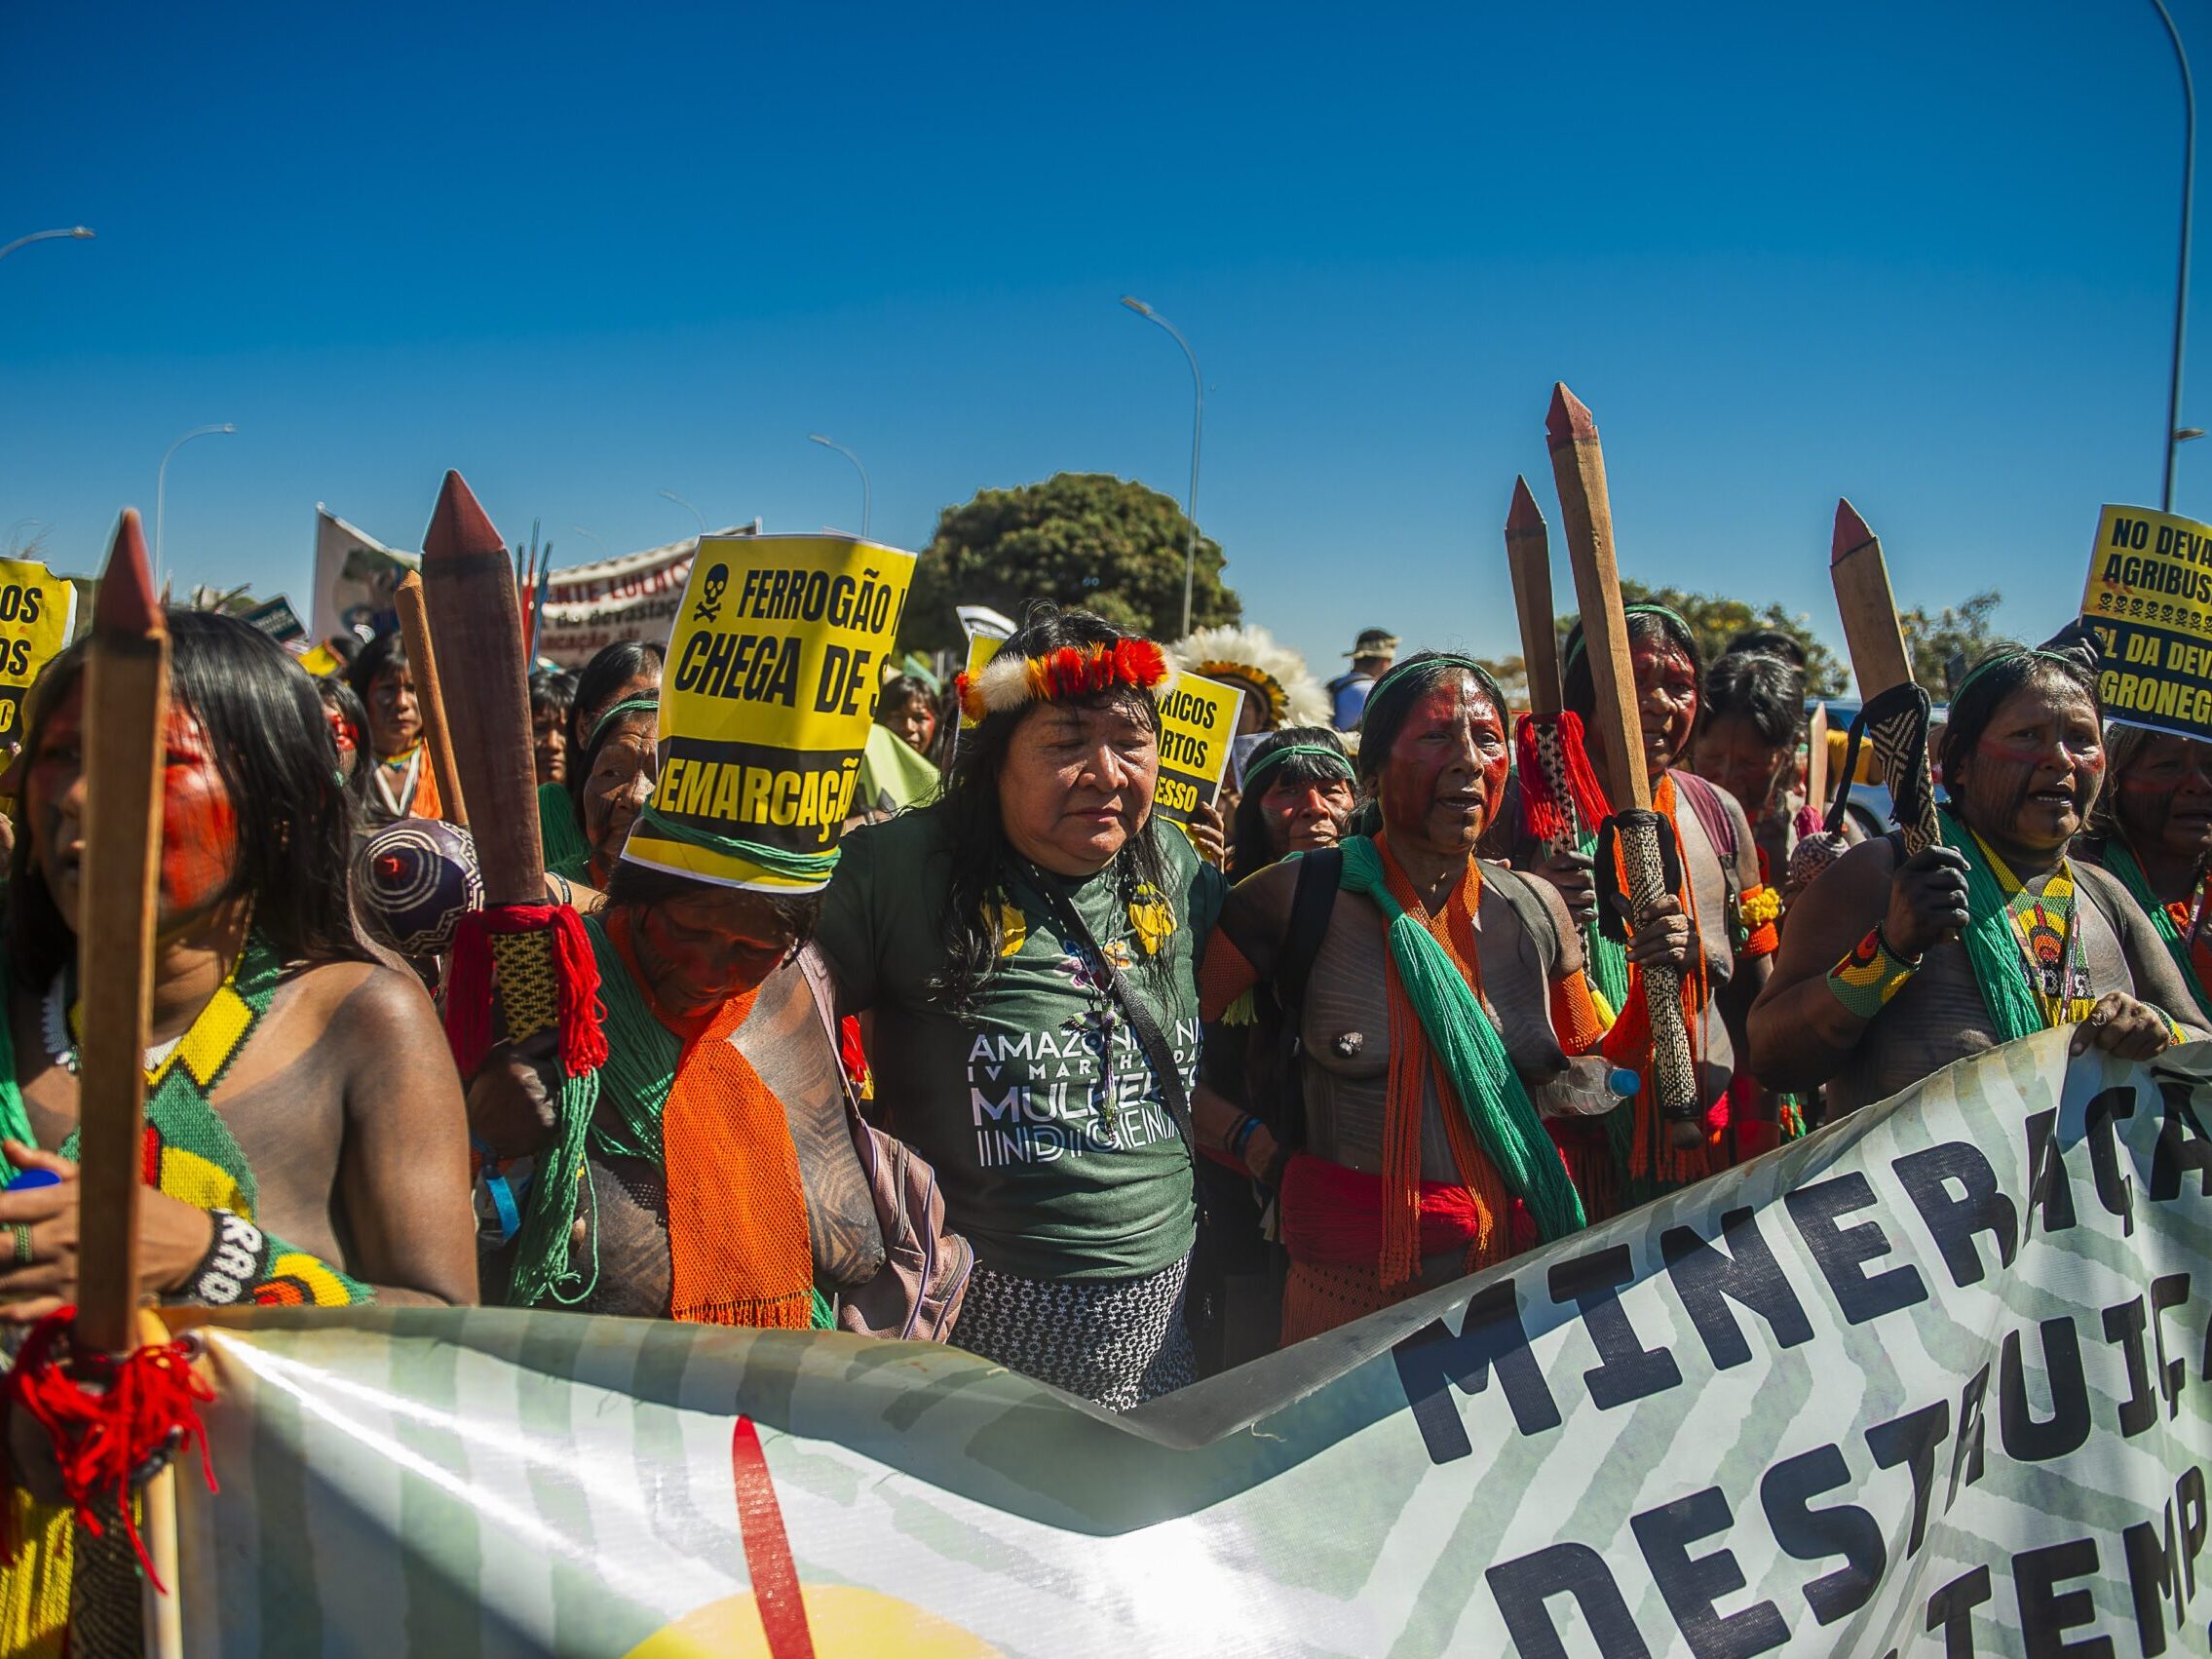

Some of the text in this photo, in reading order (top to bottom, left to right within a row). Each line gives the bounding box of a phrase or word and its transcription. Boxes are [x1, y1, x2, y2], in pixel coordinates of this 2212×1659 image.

[2111, 517, 2150, 551] NO
[0, 584, 43, 624] OS
[737, 567, 892, 635] FERROGÃO
[2102, 553, 2212, 606] AGRIBUS
[674, 630, 802, 708] CHEGA
[814, 643, 871, 716] DE
[2124, 633, 2160, 667] DA
[2166, 639, 2212, 681] DEV
[2102, 669, 2212, 726] GRONEG
[650, 757, 860, 843] EMARCAÇÃ
[1484, 1272, 2212, 1659] DESTRUIÇ
[1926, 1465, 2212, 1659] TEMP
